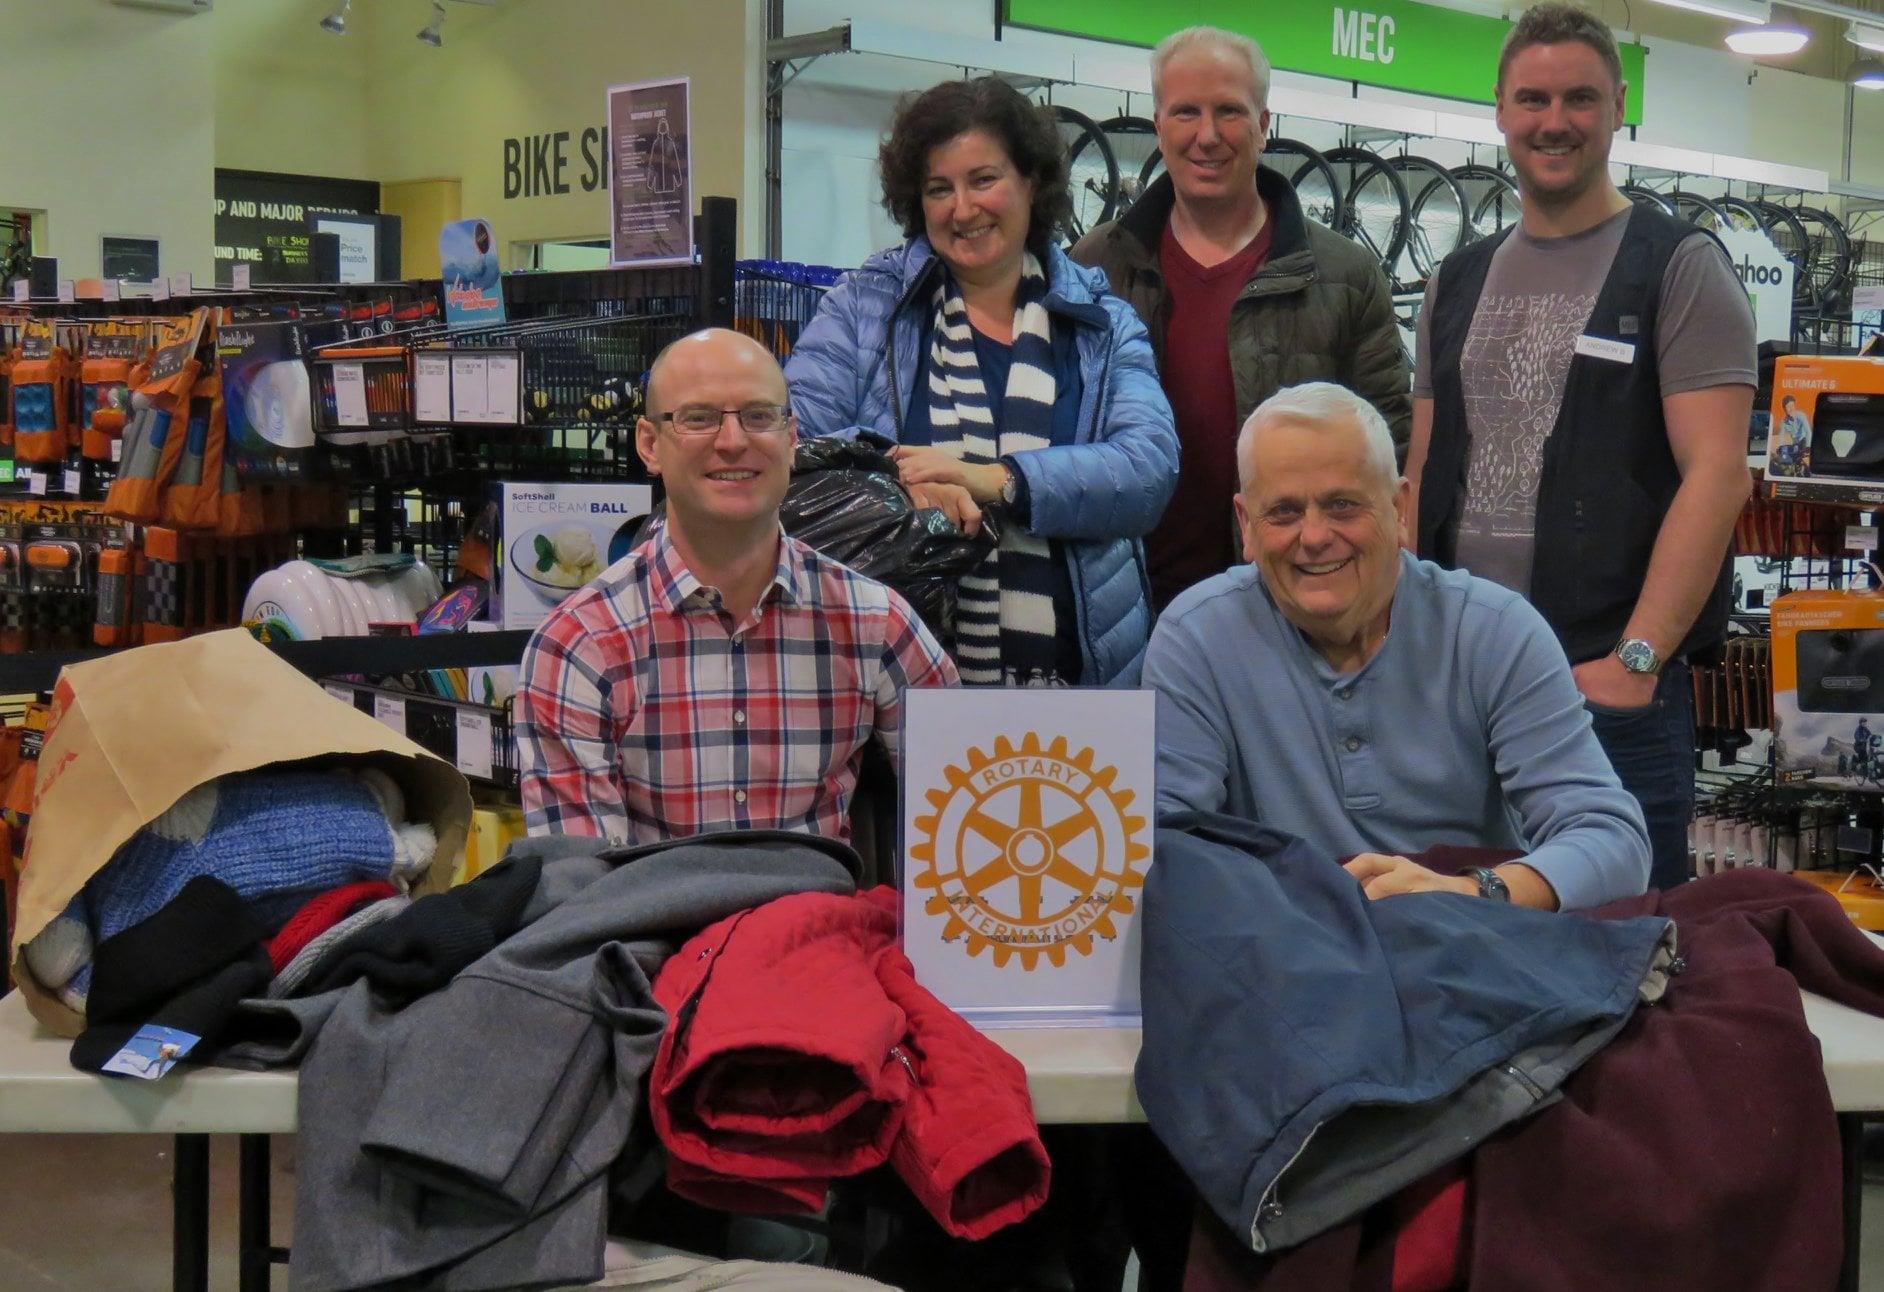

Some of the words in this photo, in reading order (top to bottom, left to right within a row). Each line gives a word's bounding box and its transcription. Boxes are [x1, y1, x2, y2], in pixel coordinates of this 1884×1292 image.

[1332, 7, 1395, 64] MEC
[504, 131, 570, 199] BIKE
[230, 200, 256, 218] AND
[260, 203, 304, 221] MAJOR
[236, 247, 263, 262] TIME:
[341, 243, 364, 252] Price
[341, 255, 367, 264] match
[512, 493, 555, 501] SoftShell
[512, 502, 534, 514] ICE
[537, 502, 587, 514] CREAM
[590, 503, 628, 514] BALL
[982, 759, 1080, 787] ROTARY
[949, 889, 1113, 943] INTERNATIONAL
